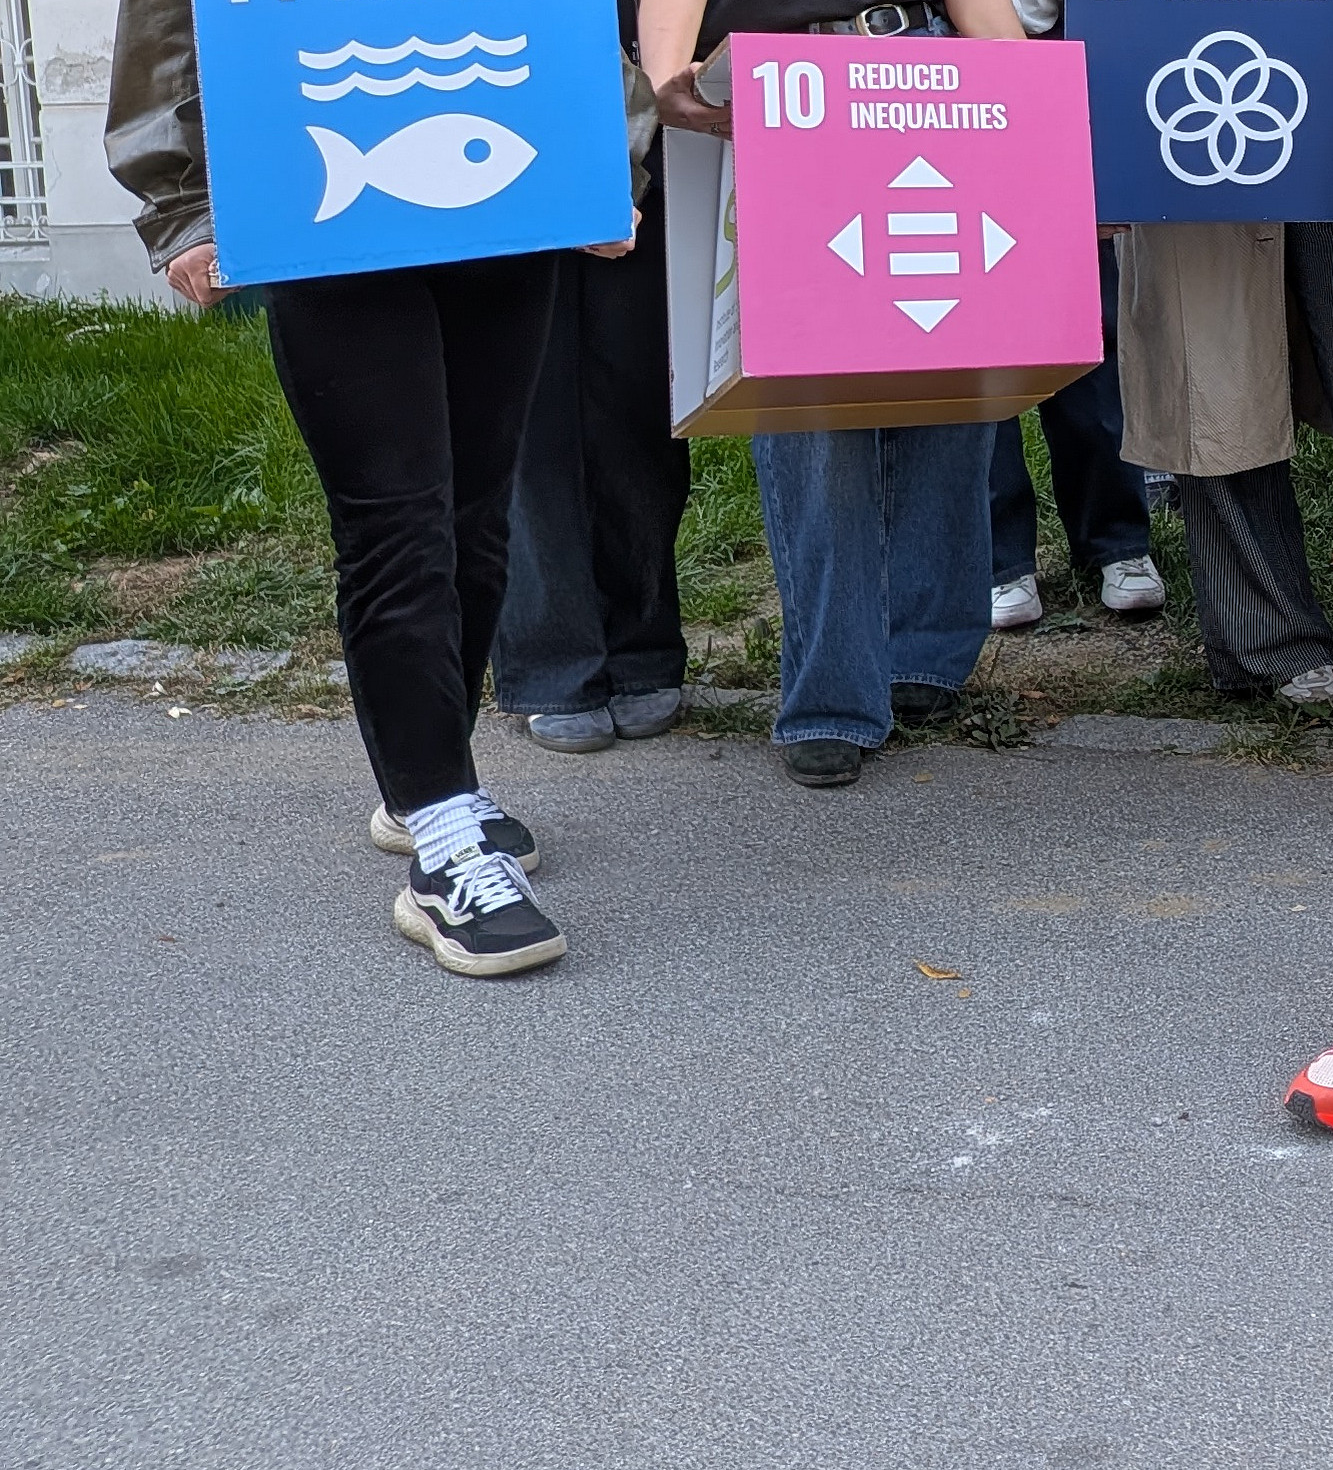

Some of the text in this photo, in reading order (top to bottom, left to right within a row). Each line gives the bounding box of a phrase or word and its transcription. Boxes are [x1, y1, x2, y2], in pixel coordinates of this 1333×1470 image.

[848, 62, 960, 91] REDUCED
[751, 61, 826, 129] 10
[849, 101, 1008, 134] INEQUALITIES
